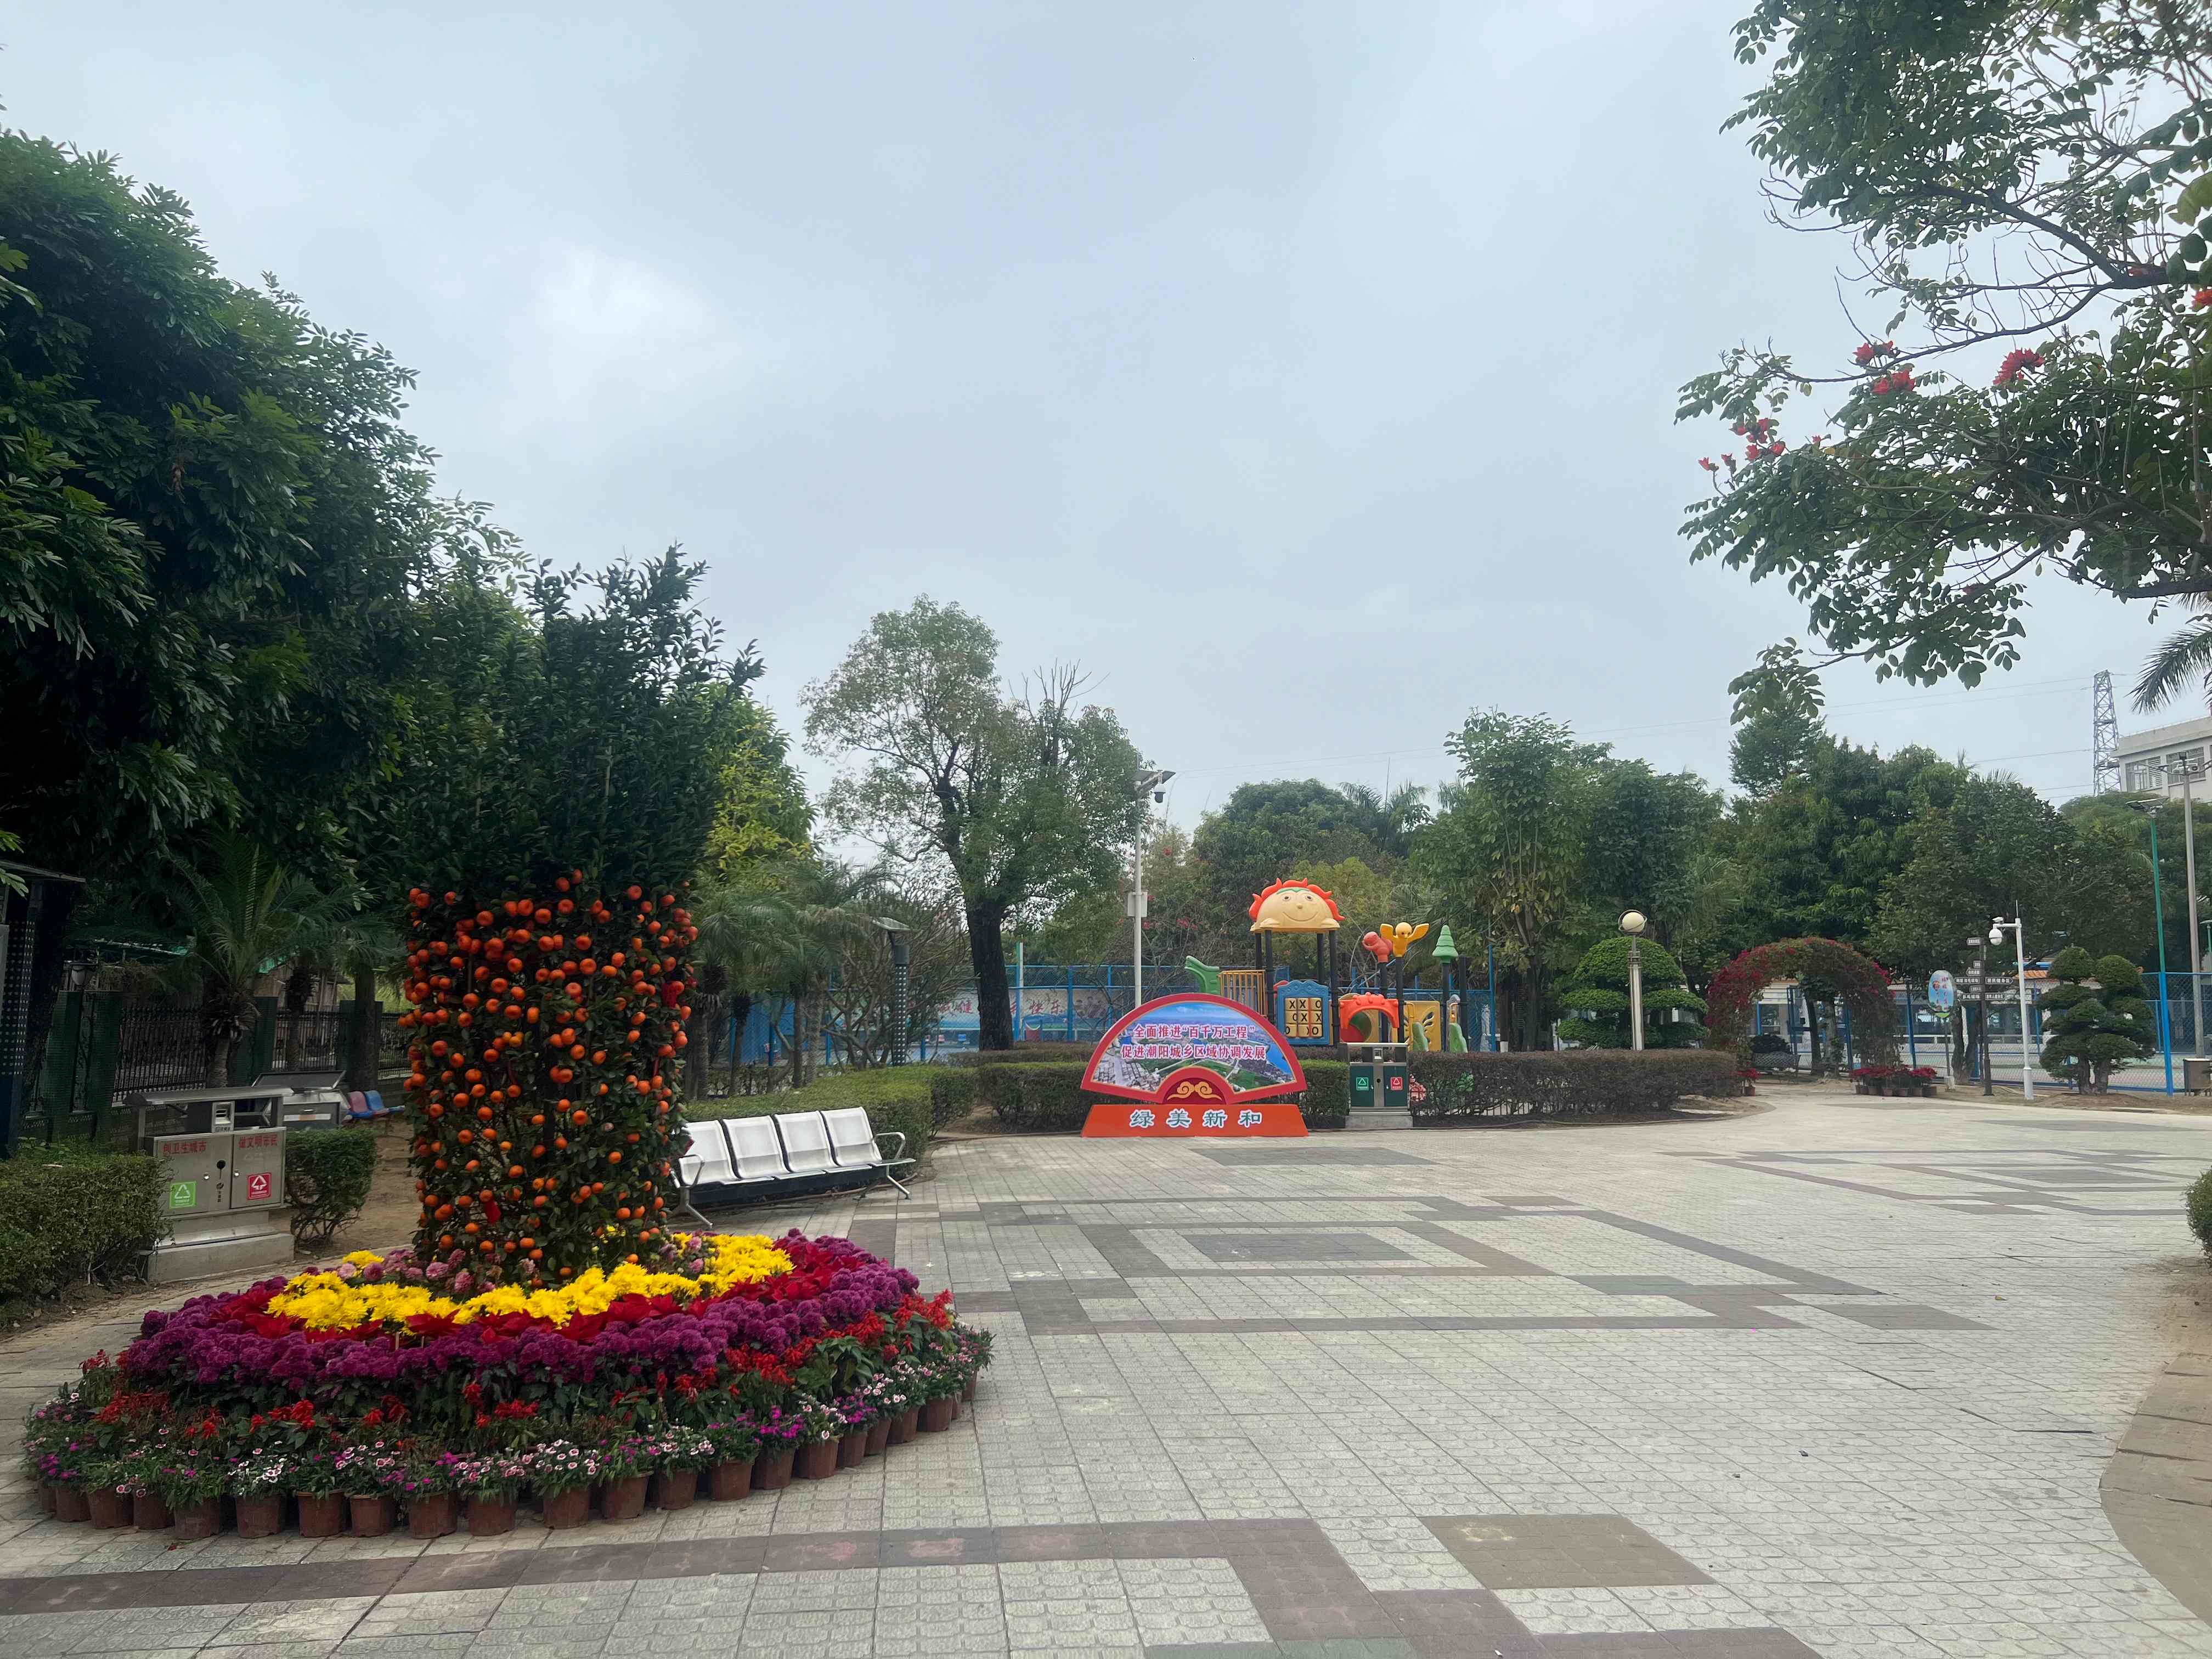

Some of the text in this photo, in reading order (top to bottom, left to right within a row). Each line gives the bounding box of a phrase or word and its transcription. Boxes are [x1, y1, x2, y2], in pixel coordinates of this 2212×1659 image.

[1289, 1000, 1295, 1008] X
[1299, 1000, 1306, 1008] X
[1301, 1013, 1307, 1022] X
[1316, 1013, 1321, 1022] X
[1134, 1024, 1255, 1039] 全面推进“百千万工程”
[1312, 1026, 1319, 1035] O
[1121, 1045, 1266, 1059] 促进潮阳城乡区域协调发展
[1130, 1109, 1262, 1127] 绿美新和
